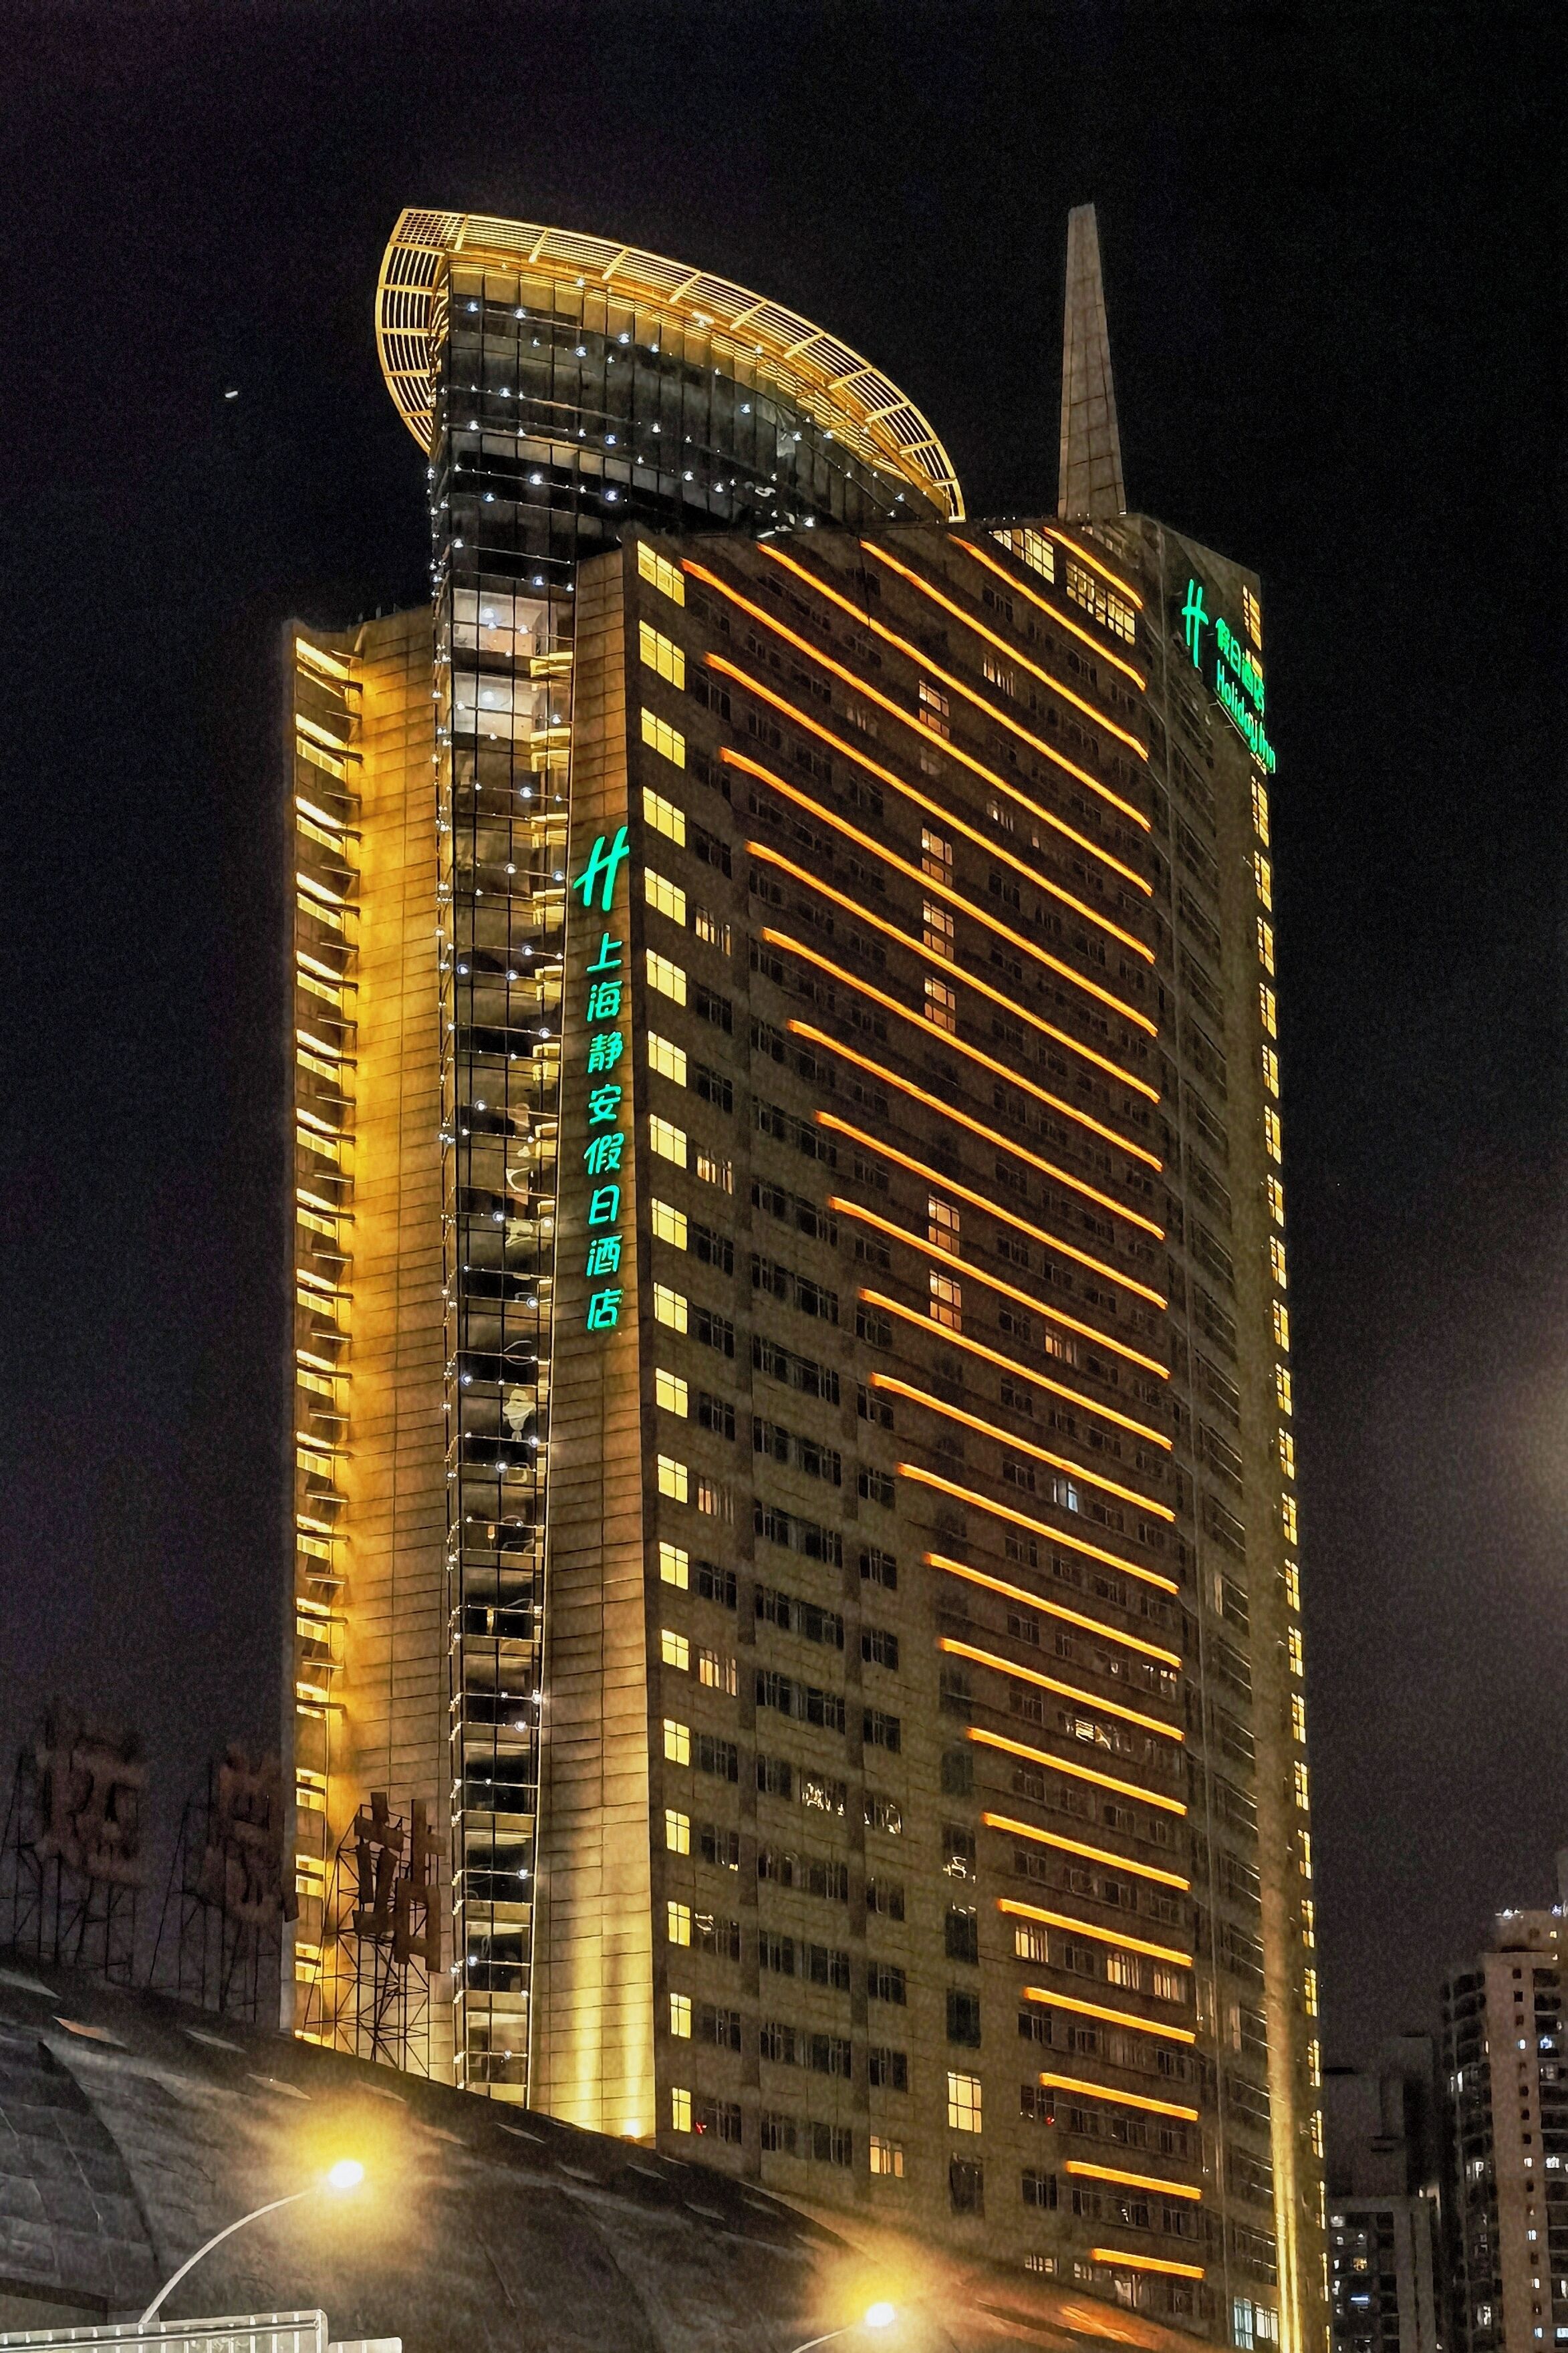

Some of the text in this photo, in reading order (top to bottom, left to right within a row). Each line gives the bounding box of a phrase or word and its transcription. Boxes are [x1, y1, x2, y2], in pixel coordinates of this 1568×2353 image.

[1216, 659, 1276, 774] Holiday Inn
[584, 933, 625, 1330] 上海静安假日酒店
